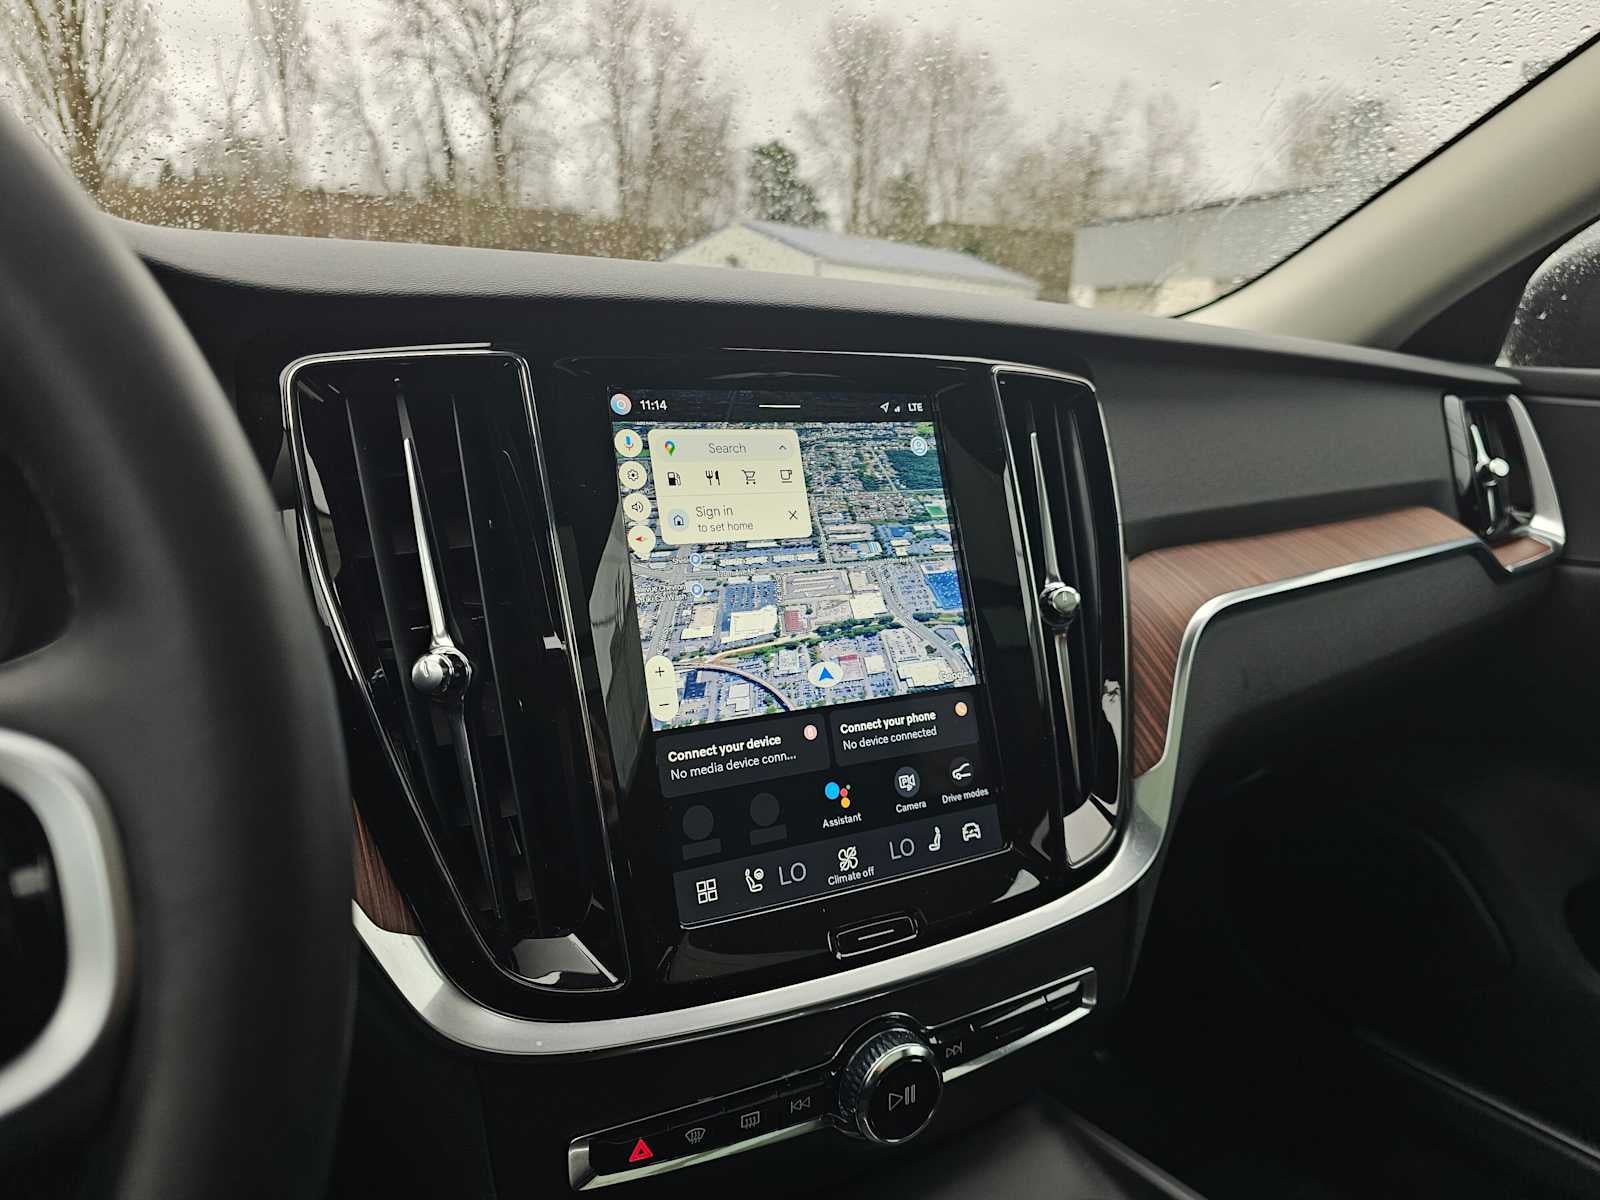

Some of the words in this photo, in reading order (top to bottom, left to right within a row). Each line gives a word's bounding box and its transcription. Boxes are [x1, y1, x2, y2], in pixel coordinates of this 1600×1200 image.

[639, 399, 668, 411] 11:14
[907, 402, 923, 412] LTE
[708, 442, 747, 454] Search
[695, 505, 721, 519] Sign
[723, 505, 734, 516] in
[698, 523, 708, 532] to
[710, 522, 725, 532] set
[727, 521, 754, 531] home
[840, 718, 882, 734] Connect
[883, 716, 906, 730] your
[906, 711, 937, 726] phone
[842, 740, 858, 750] No
[859, 735, 889, 748] device
[890, 725, 938, 743] connected
[668, 743, 718, 763] Connect
[719, 742, 746, 756] your
[746, 735, 782, 749] device
[670, 768, 688, 781] No
[690, 762, 724, 777] media
[725, 755, 760, 771] device
[761, 751, 797, 764] conn...
[941, 794, 962, 804] Drive
[963, 787, 989, 799] modes
[895, 800, 927, 813] Camera
[822, 812, 862, 829] Assistant
[888, 838, 915, 860] LO
[779, 862, 807, 886] LO
[827, 871, 861, 886] Climate
[862, 866, 875, 878] off
